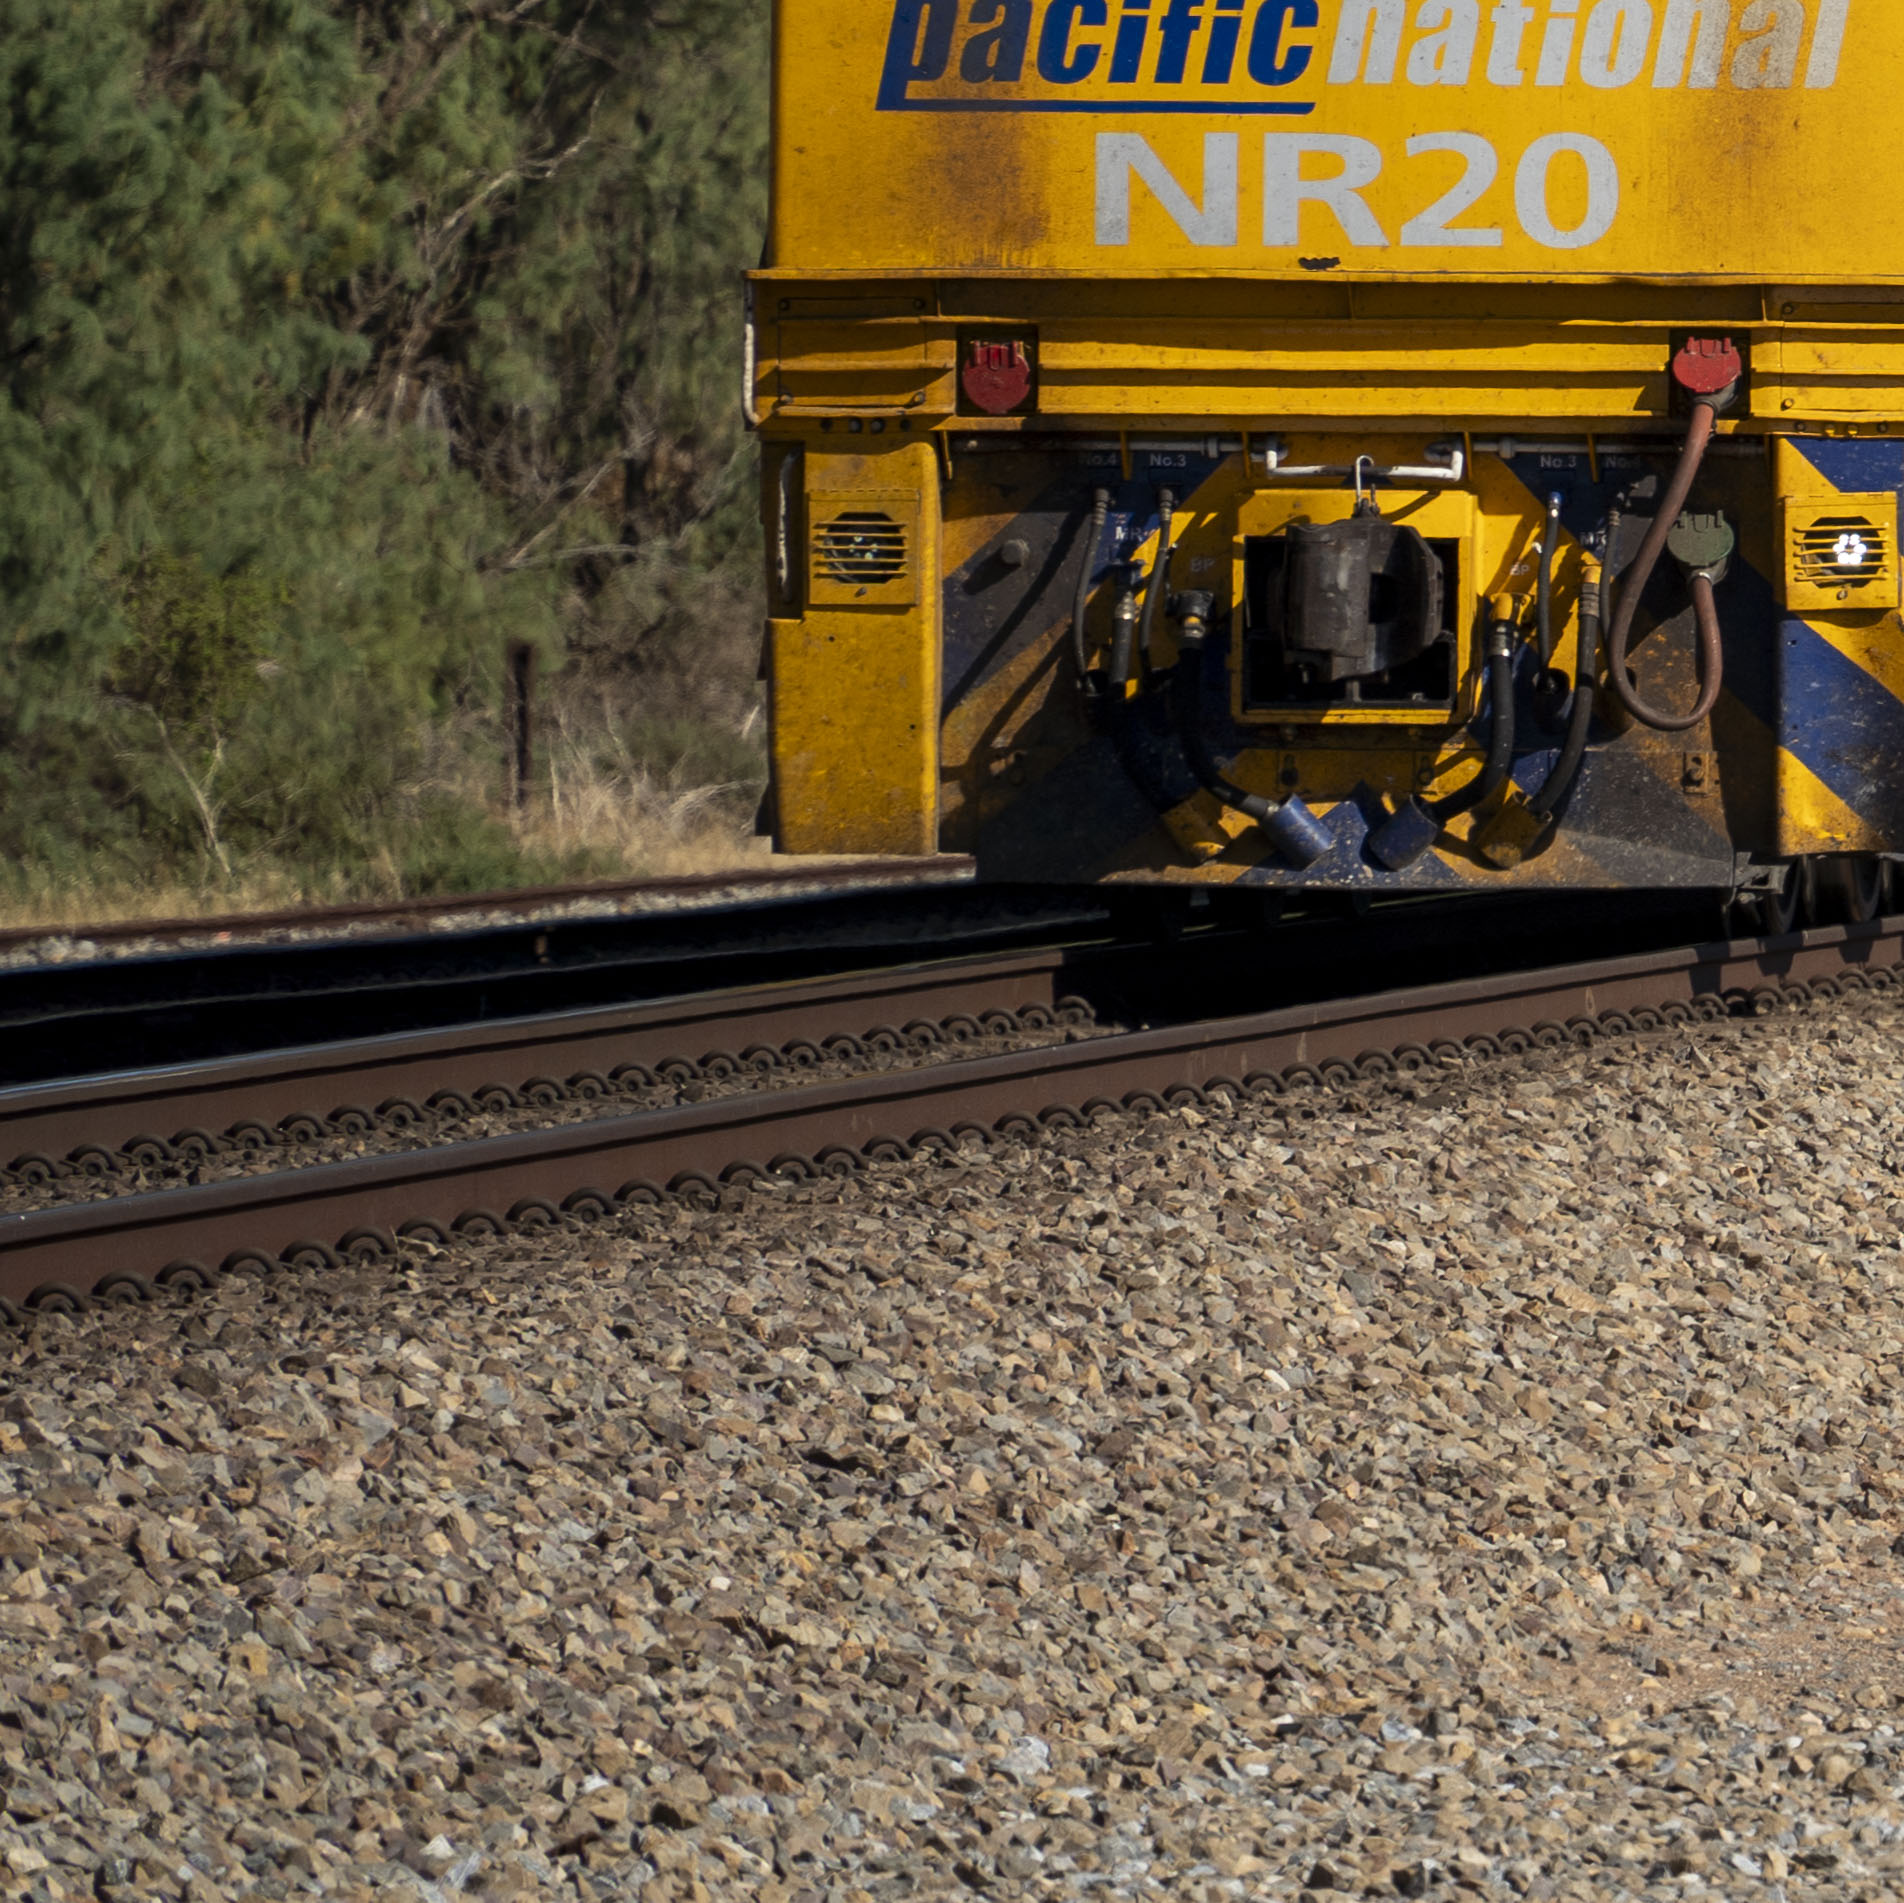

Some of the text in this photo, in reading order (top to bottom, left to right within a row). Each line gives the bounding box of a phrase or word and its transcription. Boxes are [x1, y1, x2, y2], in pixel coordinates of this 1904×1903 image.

[1093, 130, 1620, 249] NR20
[1150, 453, 1187, 467] No.3
[1540, 455, 1577, 469] No.3
